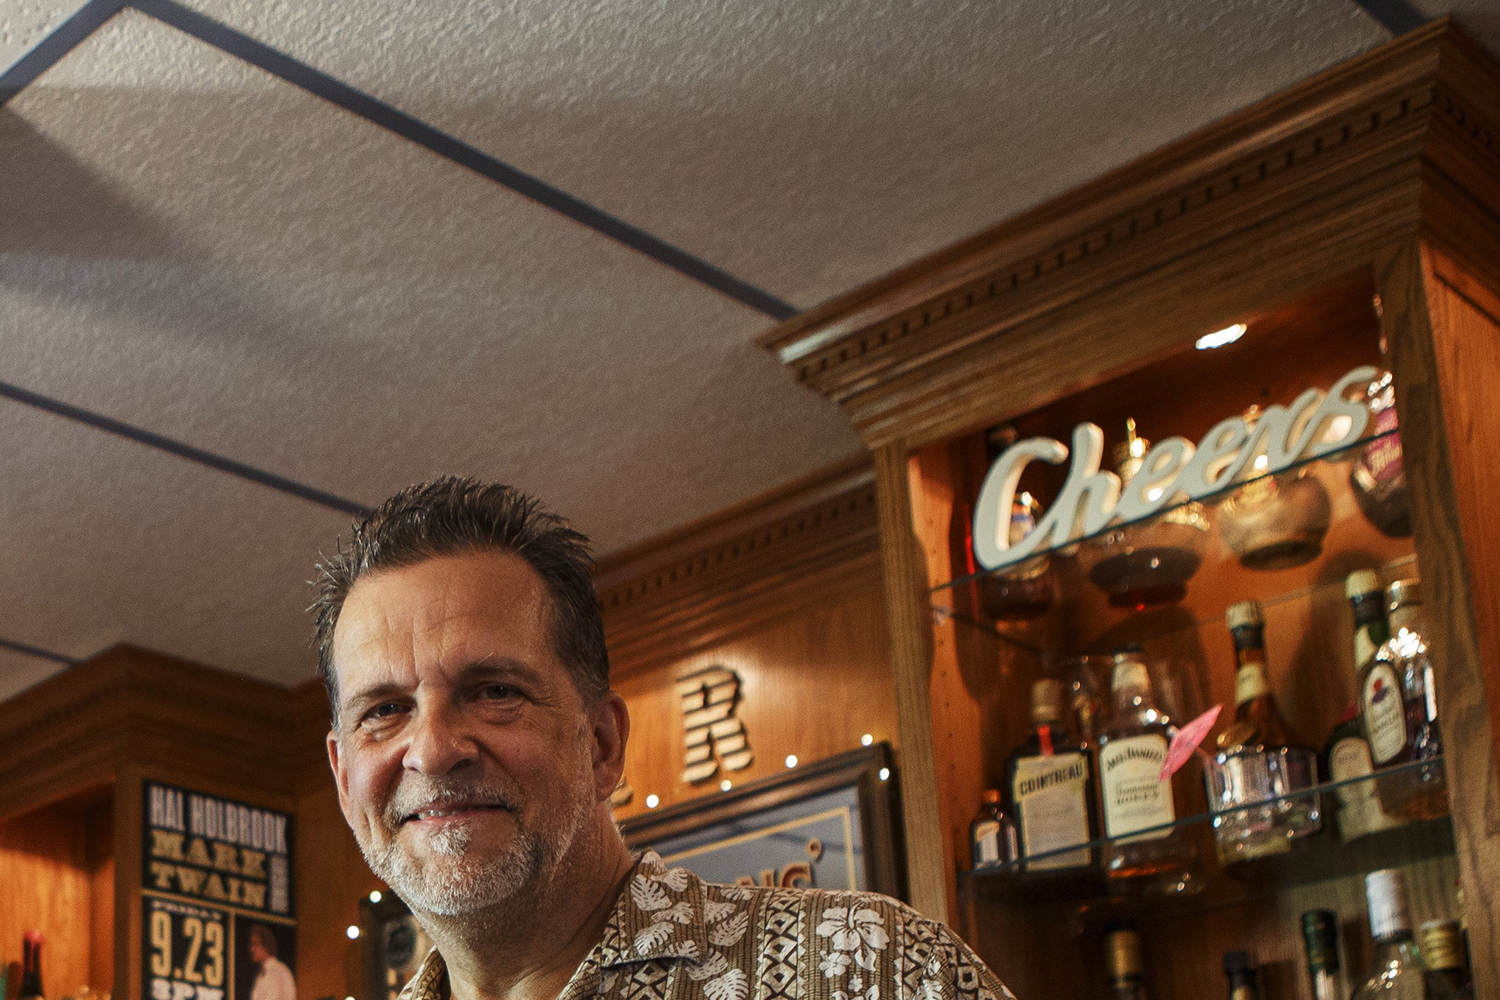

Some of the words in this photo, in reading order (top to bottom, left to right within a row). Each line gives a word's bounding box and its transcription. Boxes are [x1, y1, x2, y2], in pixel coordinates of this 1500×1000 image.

[973, 365, 1378, 571] Cheers
[1019, 762, 1084, 796] COINTREAU
[150, 785, 186, 831] HAL
[189, 794, 287, 854] HOLBROOK
[151, 829, 268, 880] MARK
[151, 861, 267, 910] TWAIN
[151, 911, 224, 987] 9.23
